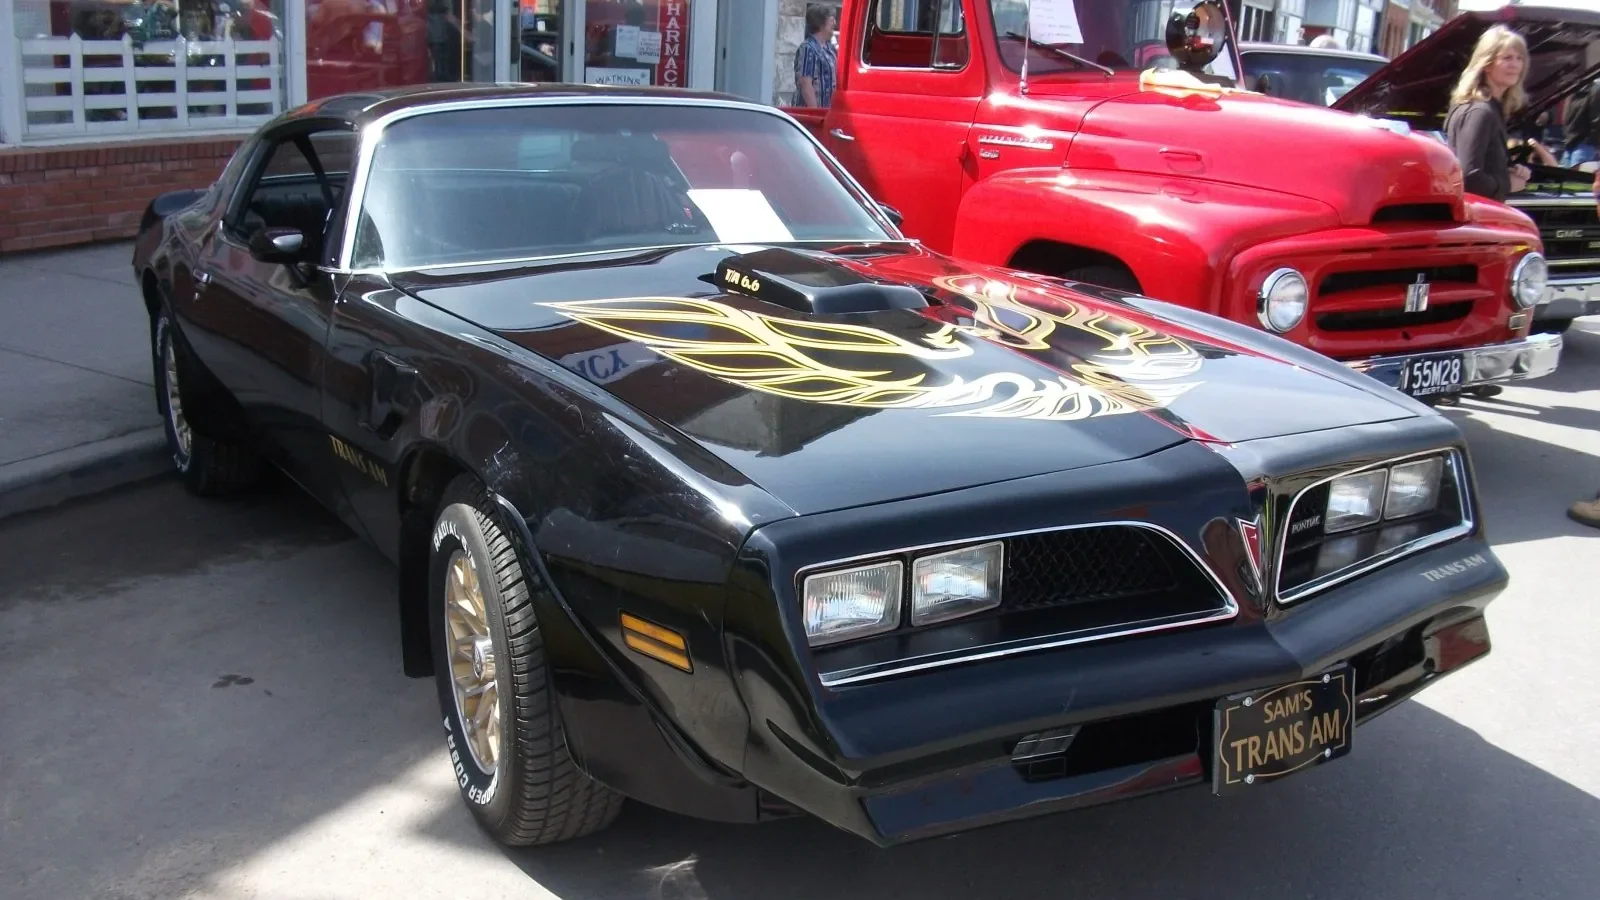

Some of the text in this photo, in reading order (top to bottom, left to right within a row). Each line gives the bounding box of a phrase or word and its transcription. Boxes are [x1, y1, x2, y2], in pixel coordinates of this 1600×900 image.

[663, 0, 681, 88] HARMAC
[595, 74, 641, 85] WATKINS
[1556, 230, 1583, 238] GMC
[725, 268, 760, 292] T/A 6.6
[1412, 386, 1445, 396] ALBERTA
[328, 434, 368, 473] TRANS
[433, 520, 460, 553] RADIAL
[1291, 515, 1321, 534] PONTIAC
[1420, 554, 1487, 582] TRANS AM
[1263, 689, 1313, 724] SAM'S
[443, 715, 469, 789] COBRA
[1230, 708, 1340, 772] TRANS AM
